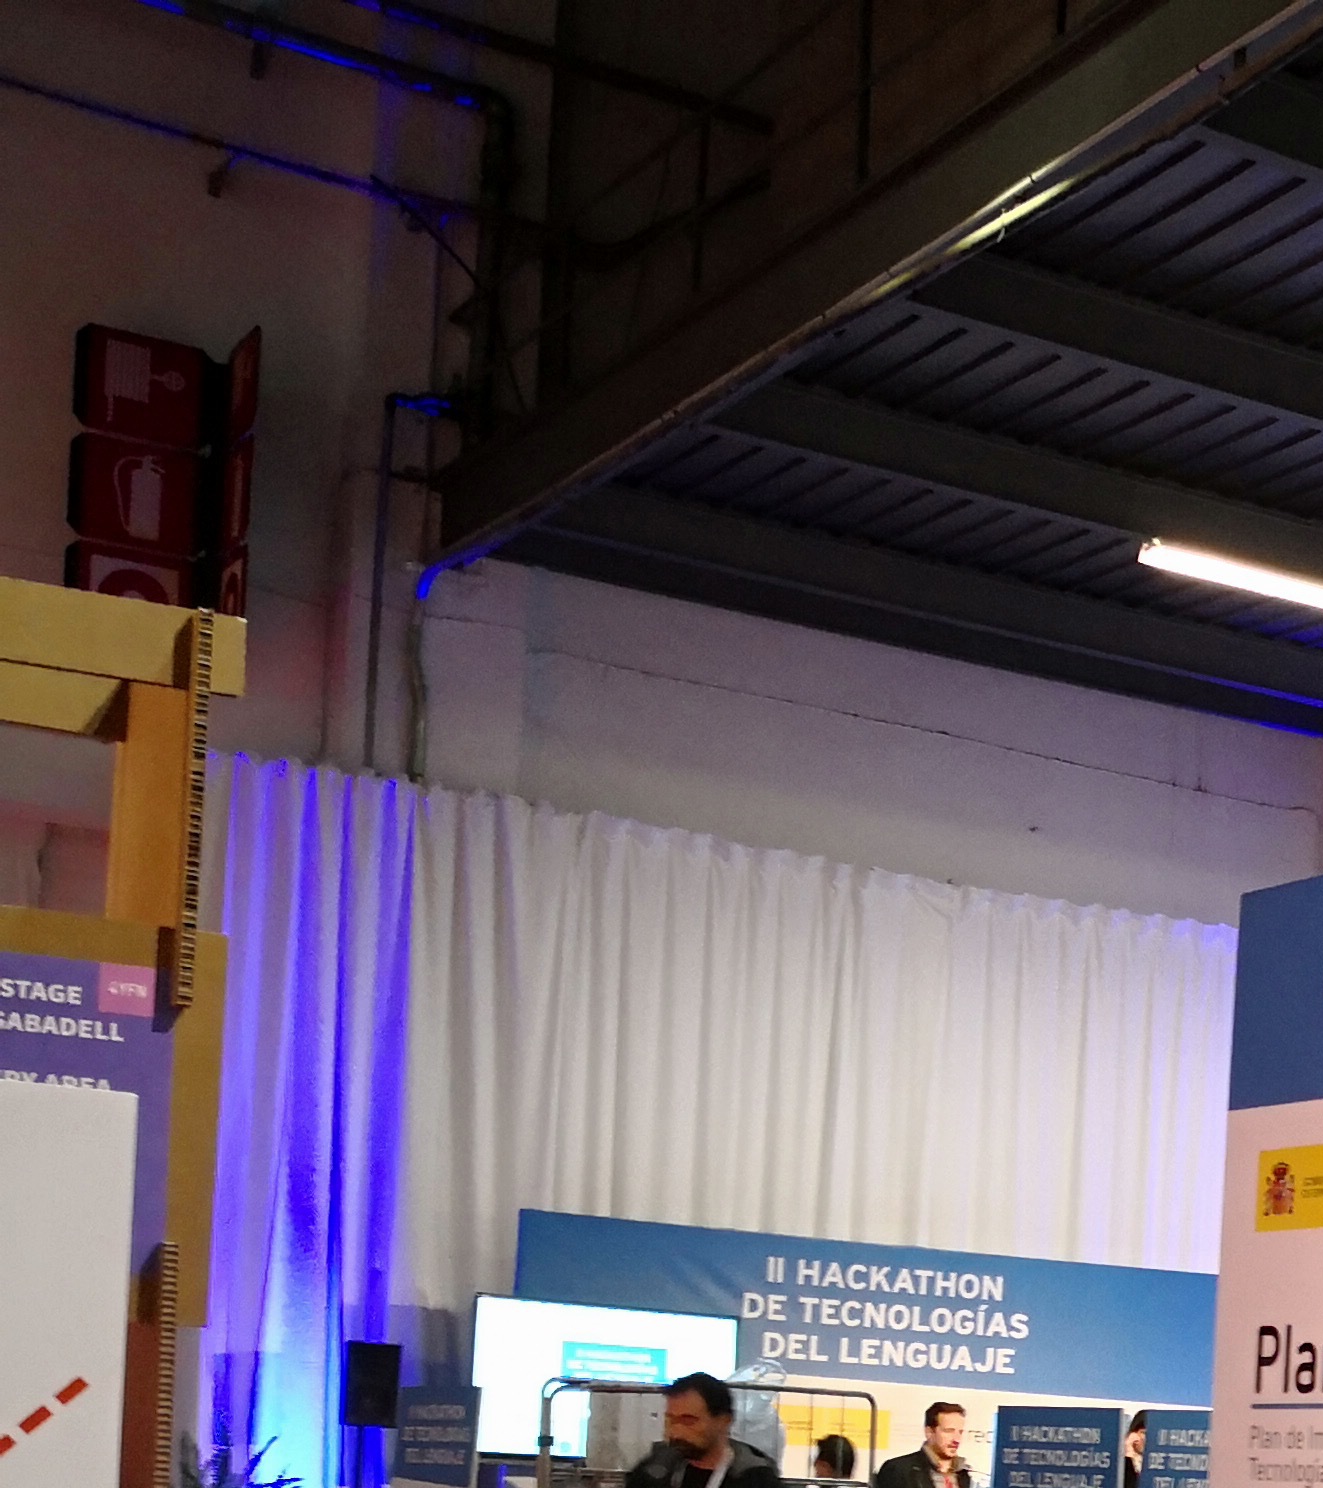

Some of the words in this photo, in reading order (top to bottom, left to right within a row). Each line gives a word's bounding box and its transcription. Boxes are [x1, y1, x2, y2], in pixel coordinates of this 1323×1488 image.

[766, 1256, 785, 1284] II
[796, 1258, 1004, 1301] HACKATHON
[742, 1292, 788, 1321] DE
[800, 1297, 1030, 1339] TECNOLOGÍAS
[762, 1332, 828, 1362] DEL
[839, 1338, 1016, 1374] LENGUAJE
[1249, 1425, 1282, 1450] Plan
[1286, 1425, 1305, 1451] de
